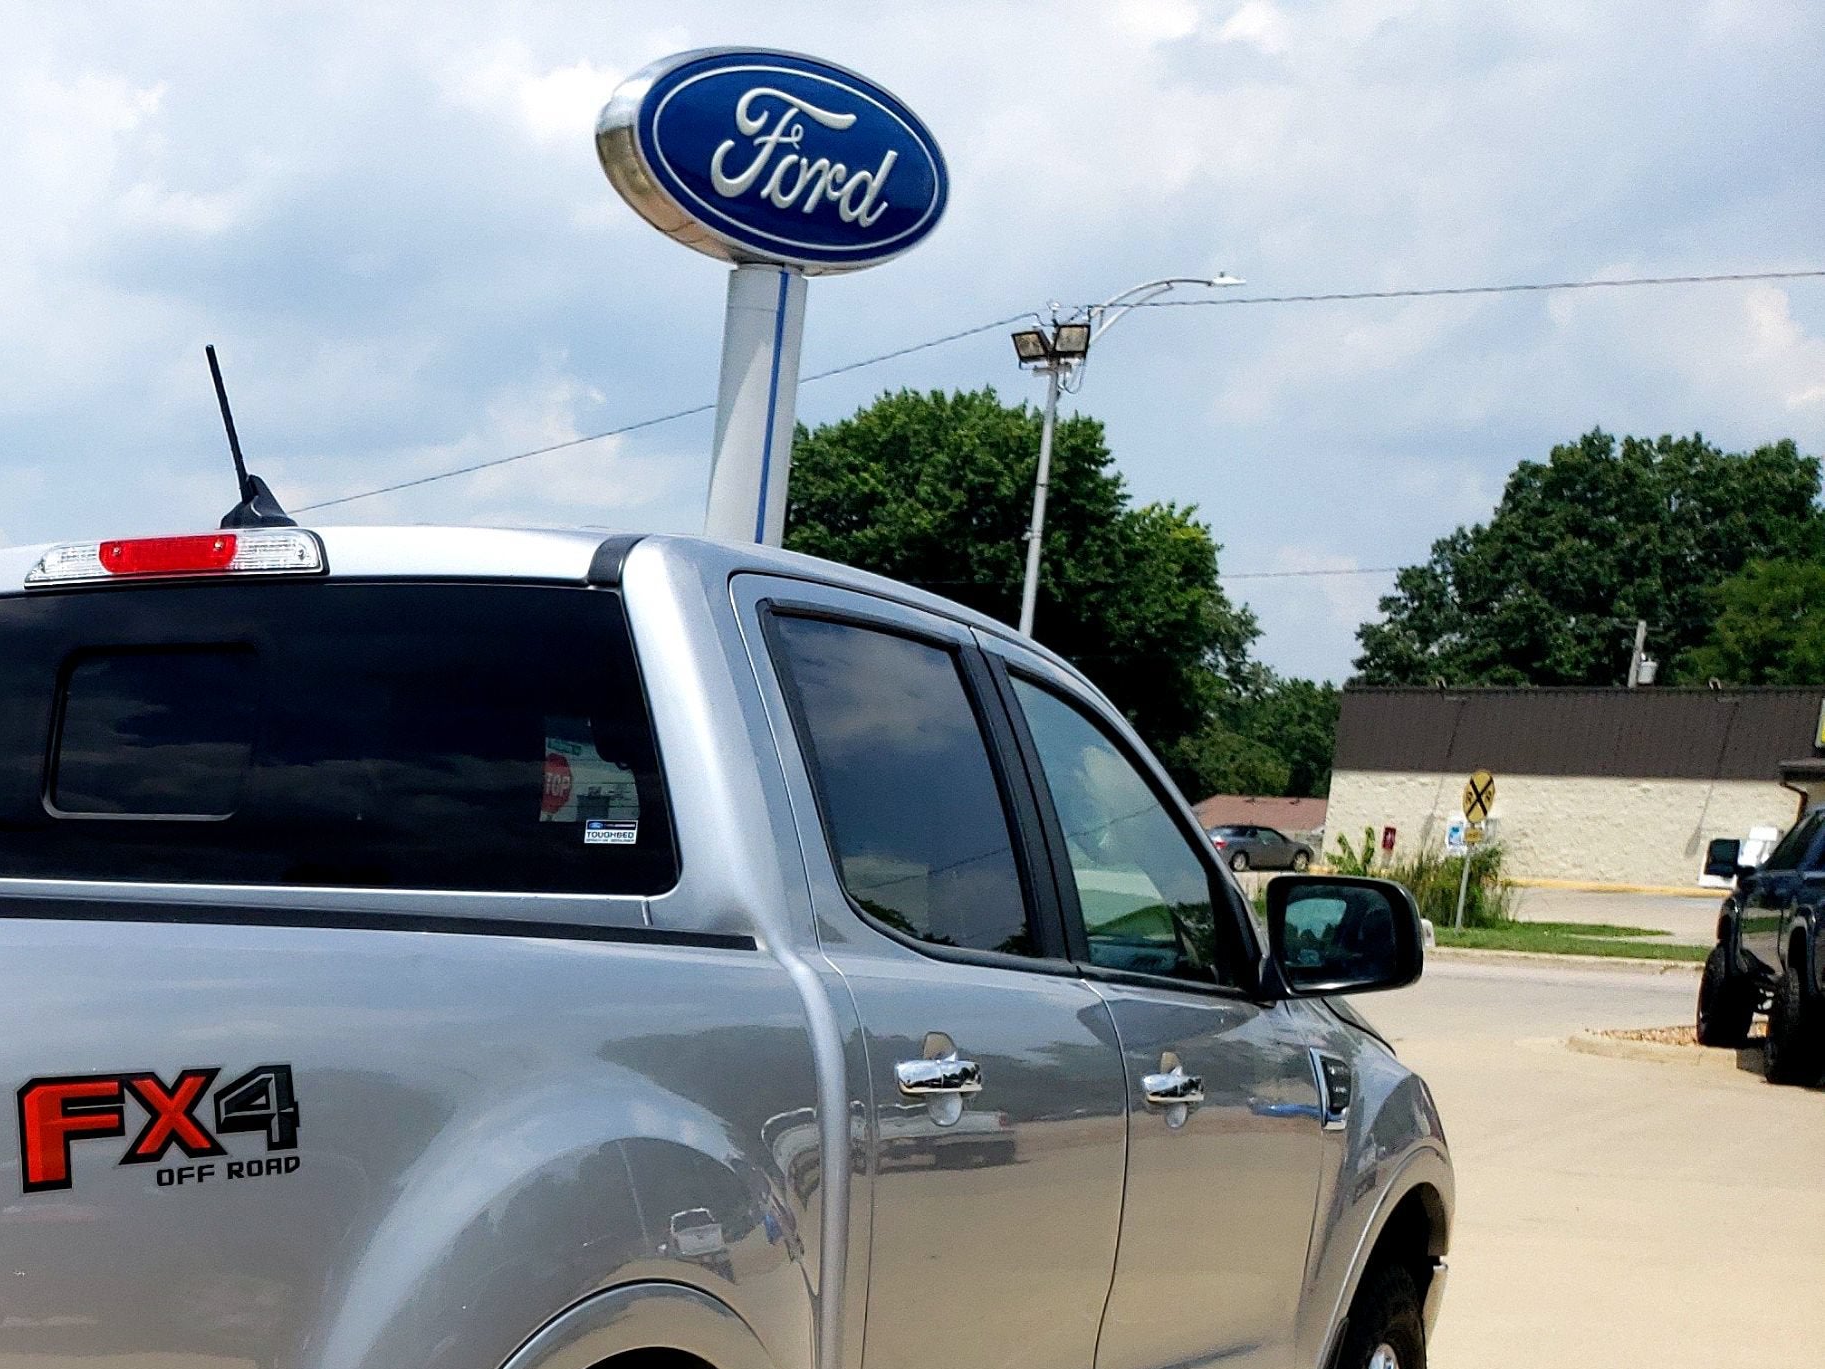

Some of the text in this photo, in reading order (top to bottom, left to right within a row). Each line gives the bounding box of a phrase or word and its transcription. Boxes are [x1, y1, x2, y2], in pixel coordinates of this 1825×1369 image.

[711, 87, 898, 228] Ford
[542, 772, 571, 798] TOP
[586, 831, 636, 840] TOUGHBED
[16, 1064, 301, 1194] FX4
[156, 1156, 301, 1187] OFF ROAD
